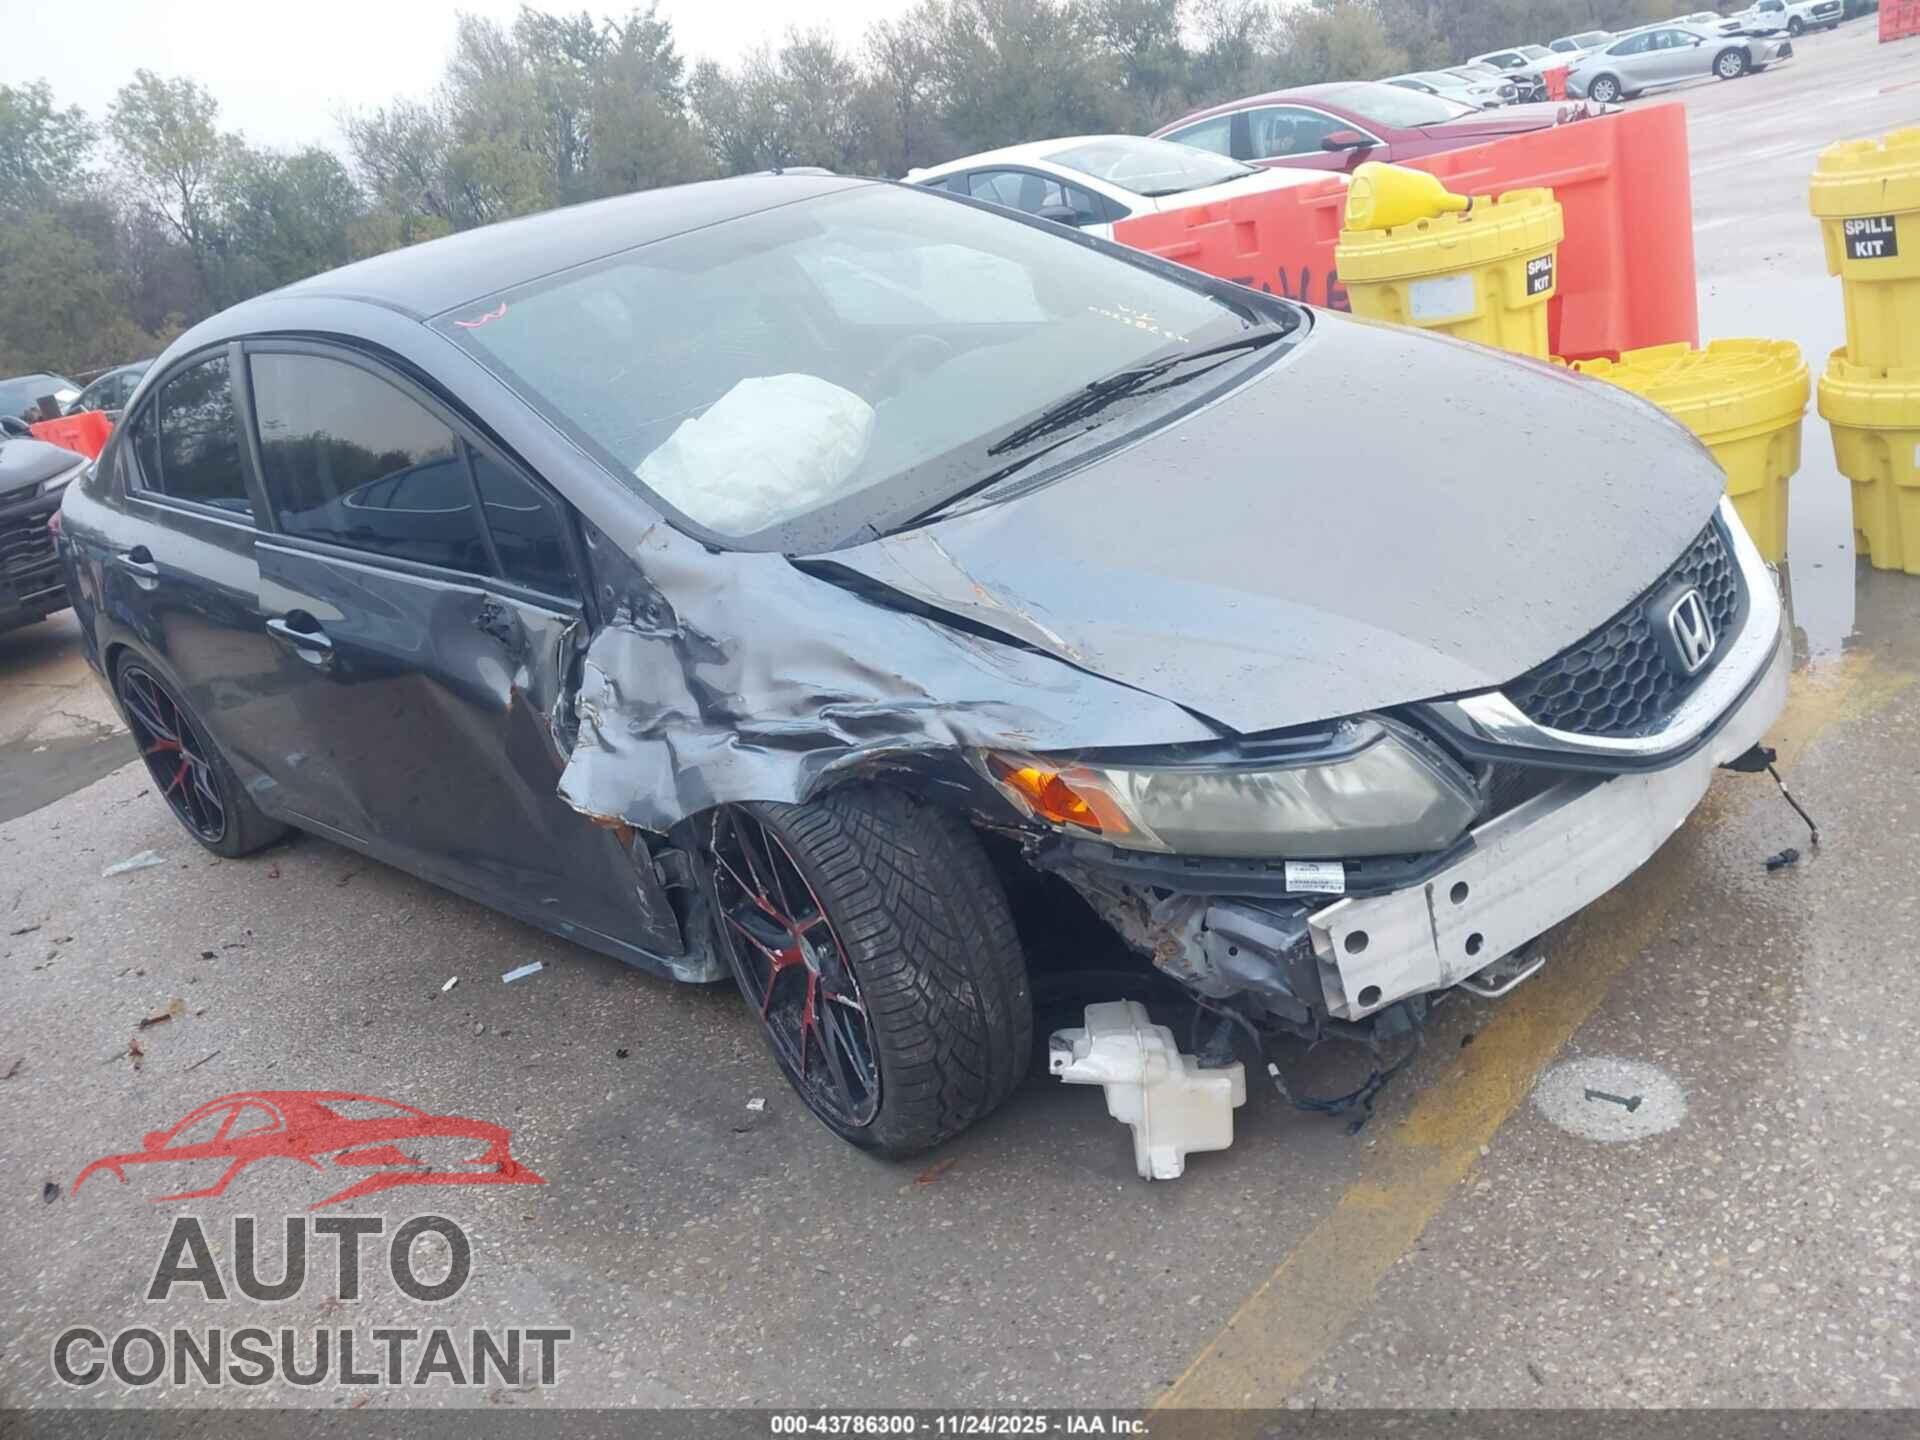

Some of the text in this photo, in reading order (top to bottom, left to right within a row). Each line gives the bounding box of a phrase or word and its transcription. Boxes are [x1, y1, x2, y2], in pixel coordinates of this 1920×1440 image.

[1845, 217, 1893, 235] SPILL
[1855, 240, 1884, 257] KIT
[1528, 256, 1552, 275] SPILL
[1534, 275, 1549, 291] KIT
